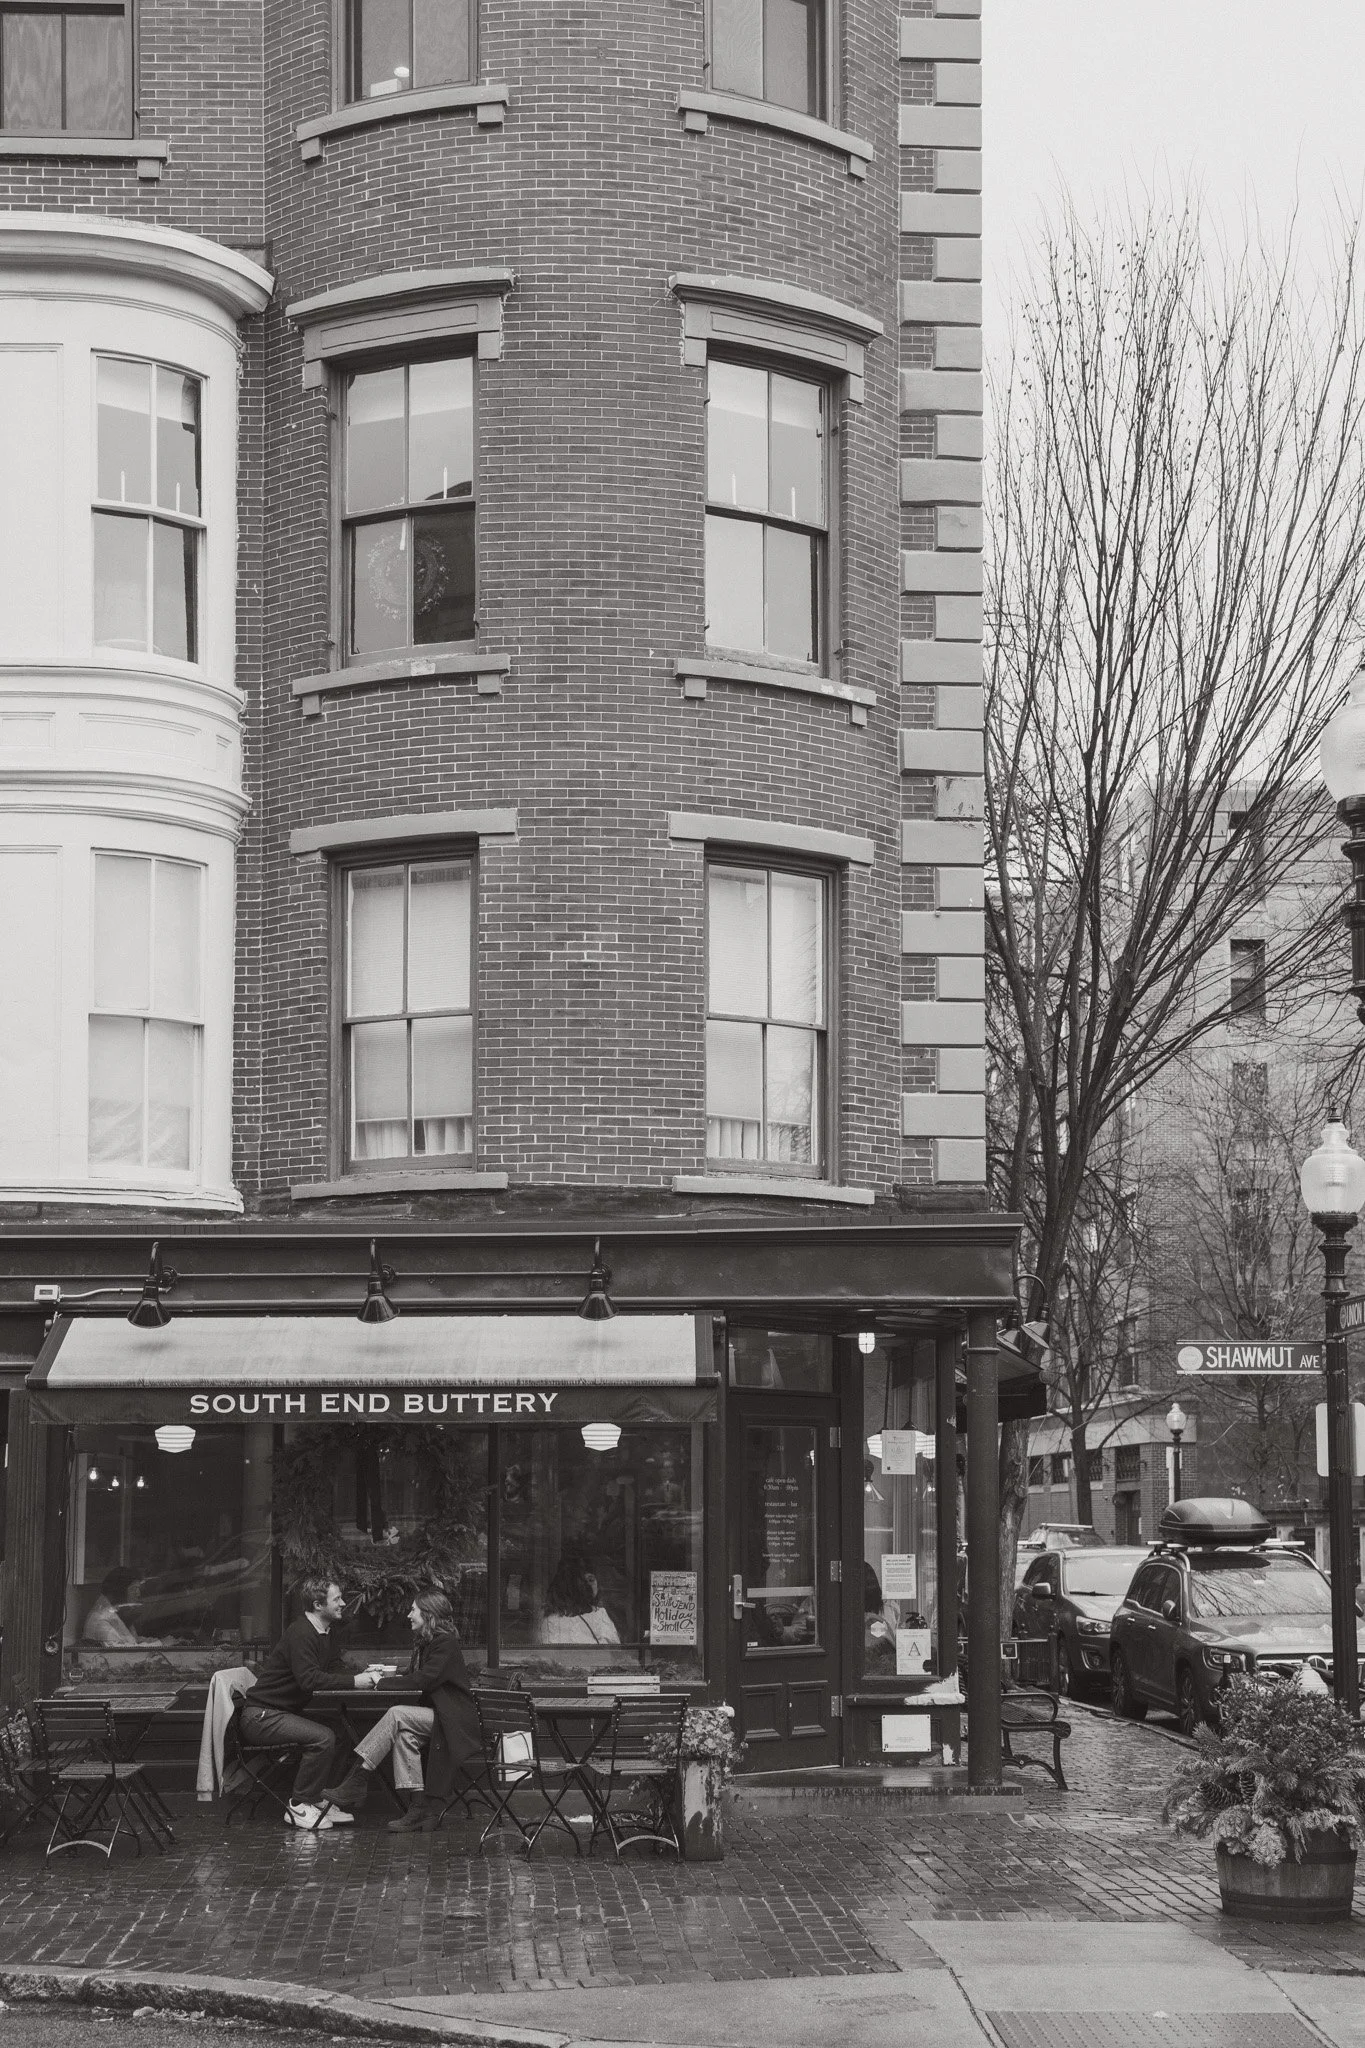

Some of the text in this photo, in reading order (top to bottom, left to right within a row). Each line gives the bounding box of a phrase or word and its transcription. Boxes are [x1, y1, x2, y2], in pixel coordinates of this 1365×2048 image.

[1346, 1302, 1362, 1328] UNION
[1205, 1346, 1320, 1368] SHAWMUT AVE
[190, 1392, 558, 1414] SOUTH END BUTTERY
[654, 1607, 693, 1622] Holiday
[657, 1620, 680, 1632] Stroll
[908, 1641, 921, 1656] A
